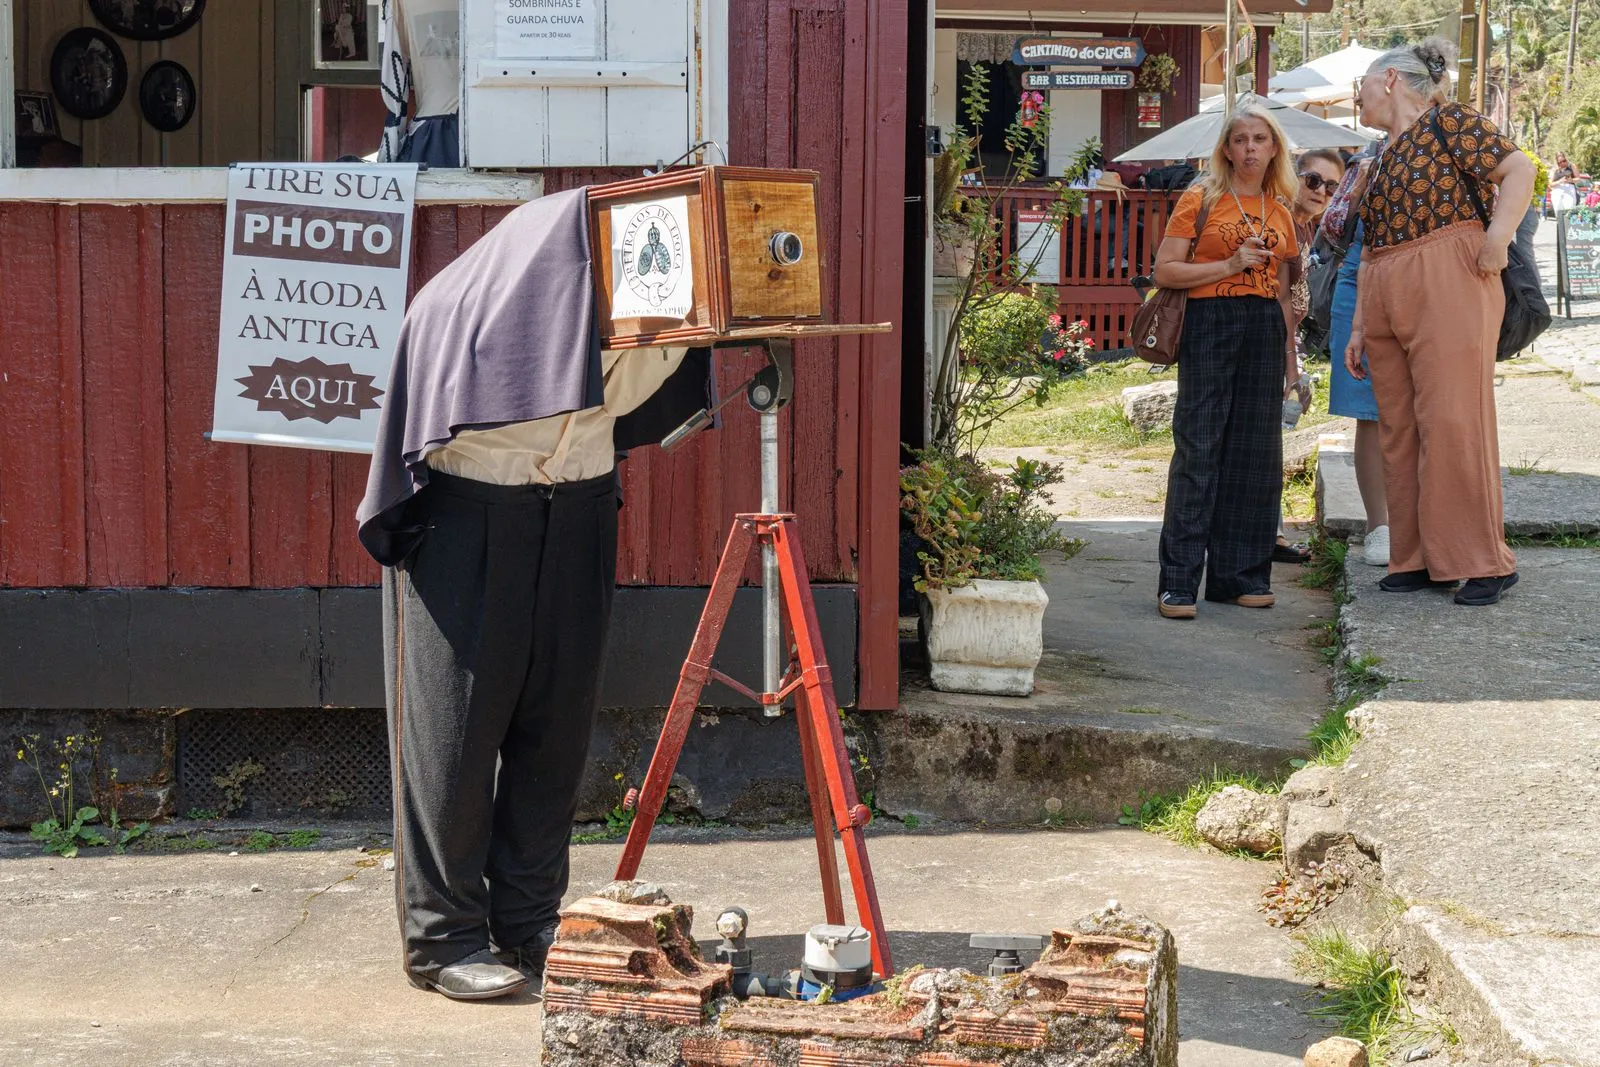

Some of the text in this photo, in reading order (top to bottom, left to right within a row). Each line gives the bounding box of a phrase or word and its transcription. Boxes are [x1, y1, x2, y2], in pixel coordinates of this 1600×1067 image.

[507, 15, 584, 24] GUARDA CHUVA
[509, 0, 581, 8] SOMBRINHAS E
[1021, 44, 1131, 60] CANTINHO do GUGA
[1029, 74, 1127, 86] BAR RESTAURANTE
[239, 167, 404, 201] TIRE SUA
[243, 213, 393, 255] PHOTO
[623, 207, 651, 275] RETRATOS
[657, 208, 670, 221] DE
[240, 268, 387, 311] À MODA
[238, 314, 380, 350] ANTIGA
[264, 376, 357, 408] AQUI
